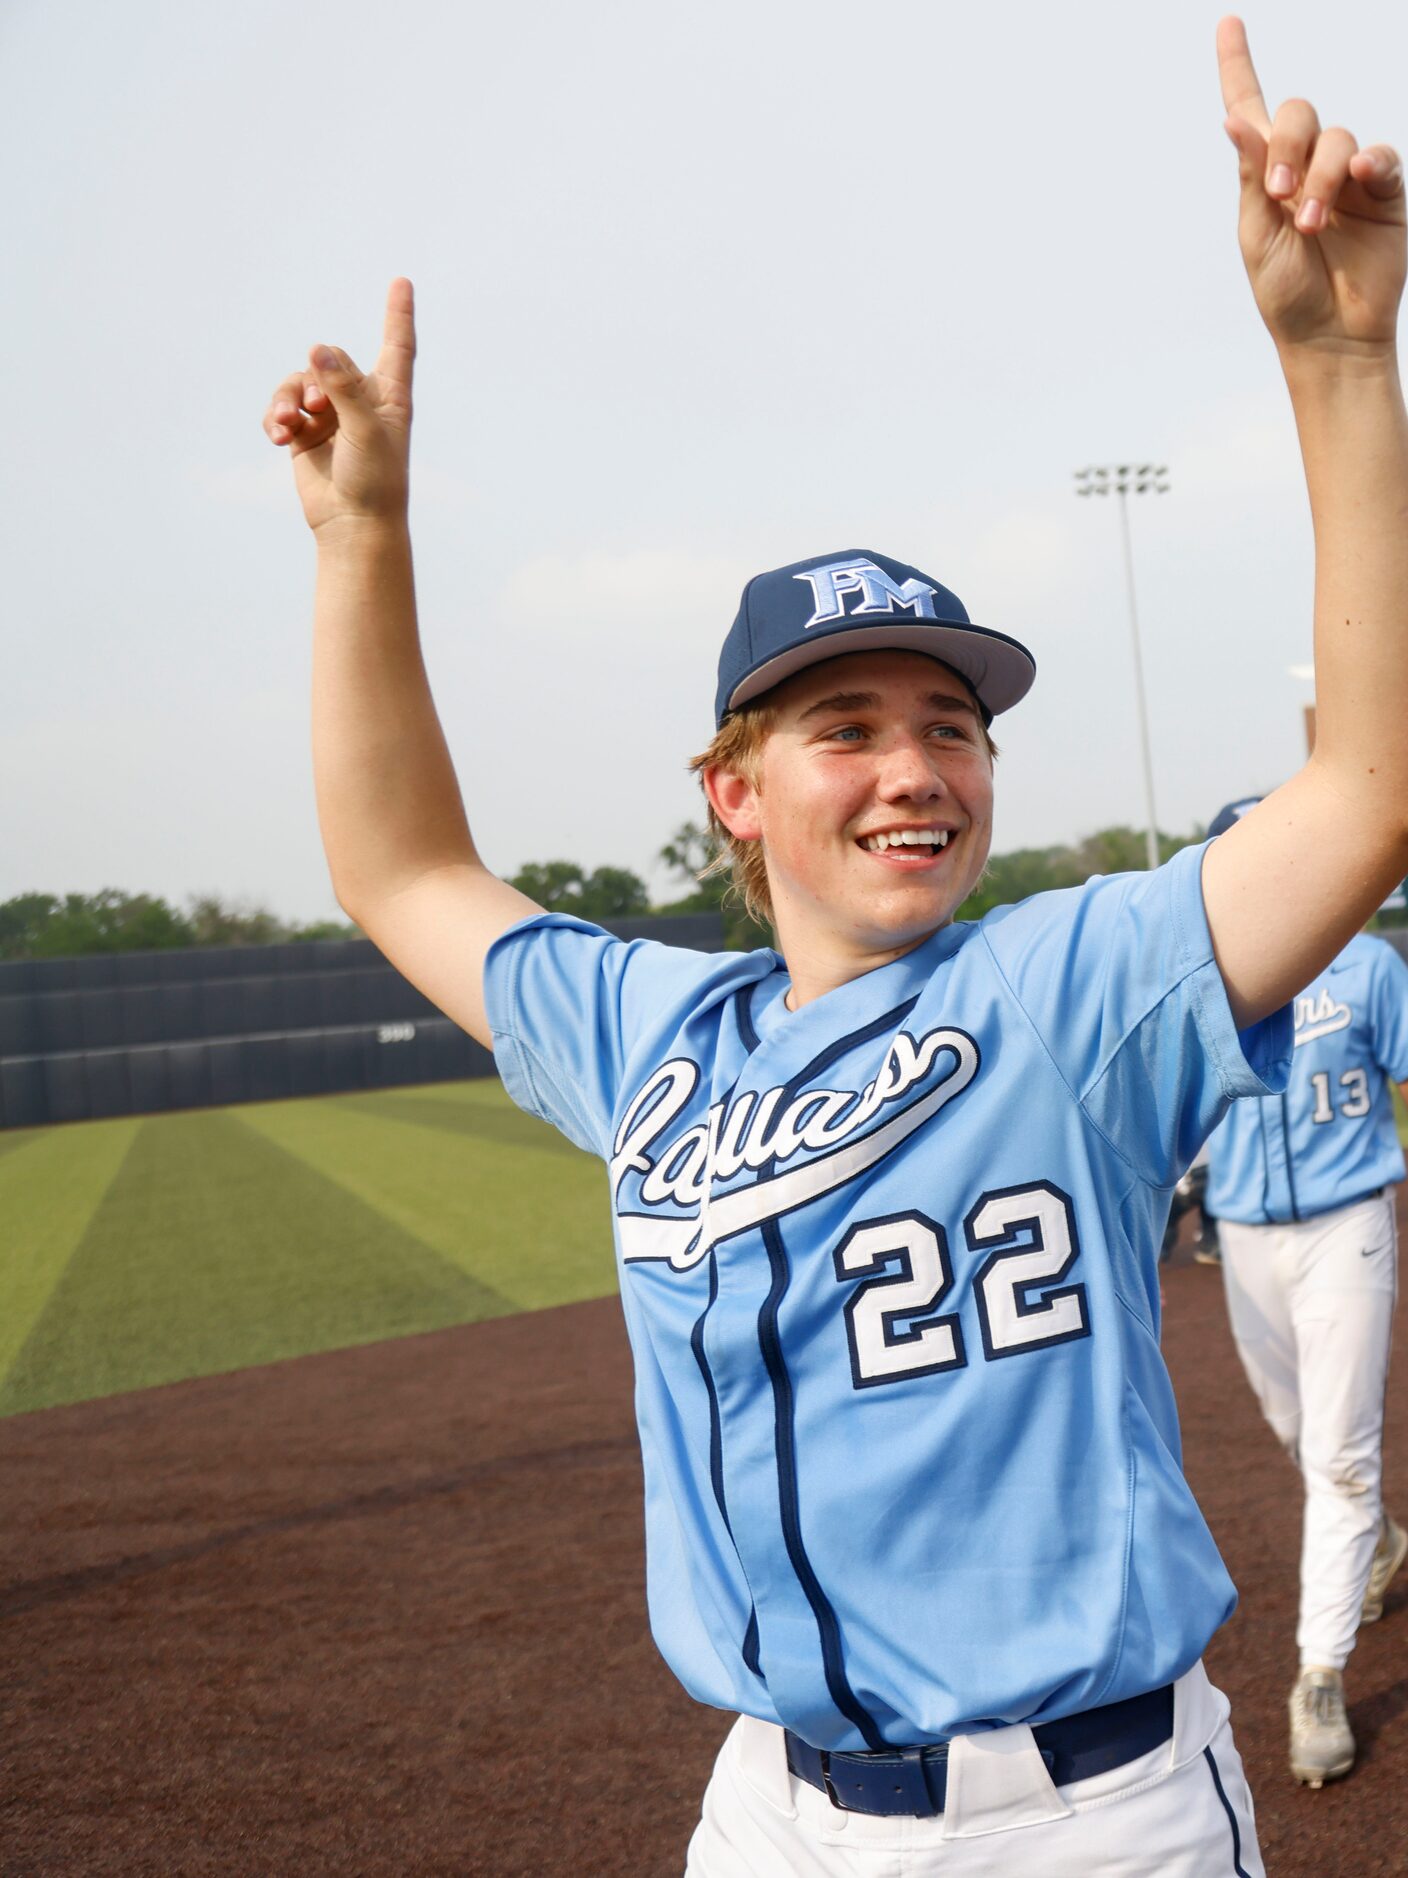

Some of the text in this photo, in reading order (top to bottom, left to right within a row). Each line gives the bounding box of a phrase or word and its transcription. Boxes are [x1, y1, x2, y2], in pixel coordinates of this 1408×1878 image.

[792, 558, 938, 629] FM
[1310, 1066, 1371, 1125] 13
[832, 1178, 1093, 1391] 22
